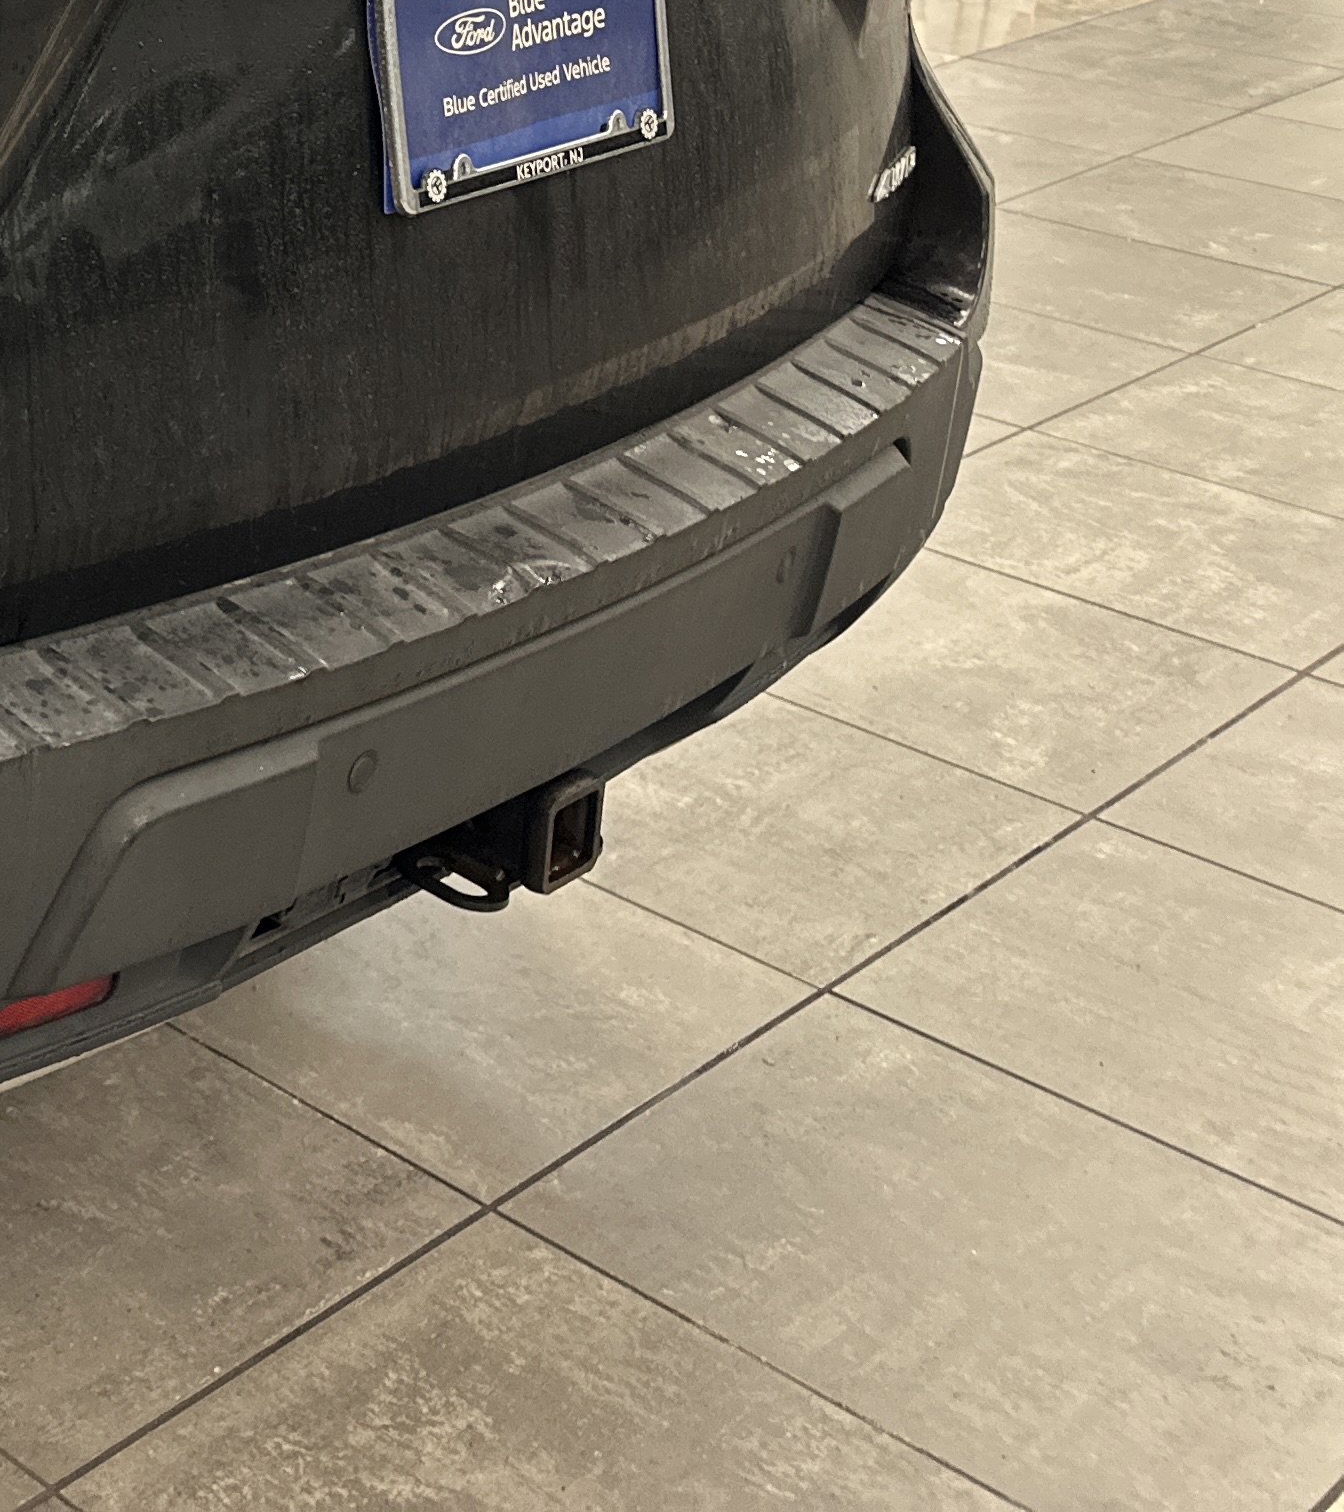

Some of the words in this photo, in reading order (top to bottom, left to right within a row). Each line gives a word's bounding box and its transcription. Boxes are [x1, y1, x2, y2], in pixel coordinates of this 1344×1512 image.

[511, 5, 606, 52] Advantage
[442, 94, 476, 118] Blue
[478, 76, 528, 109] Certified
[529, 66, 561, 92] Used
[563, 53, 612, 83] Vehicle
[569, 146, 585, 165] NJ
